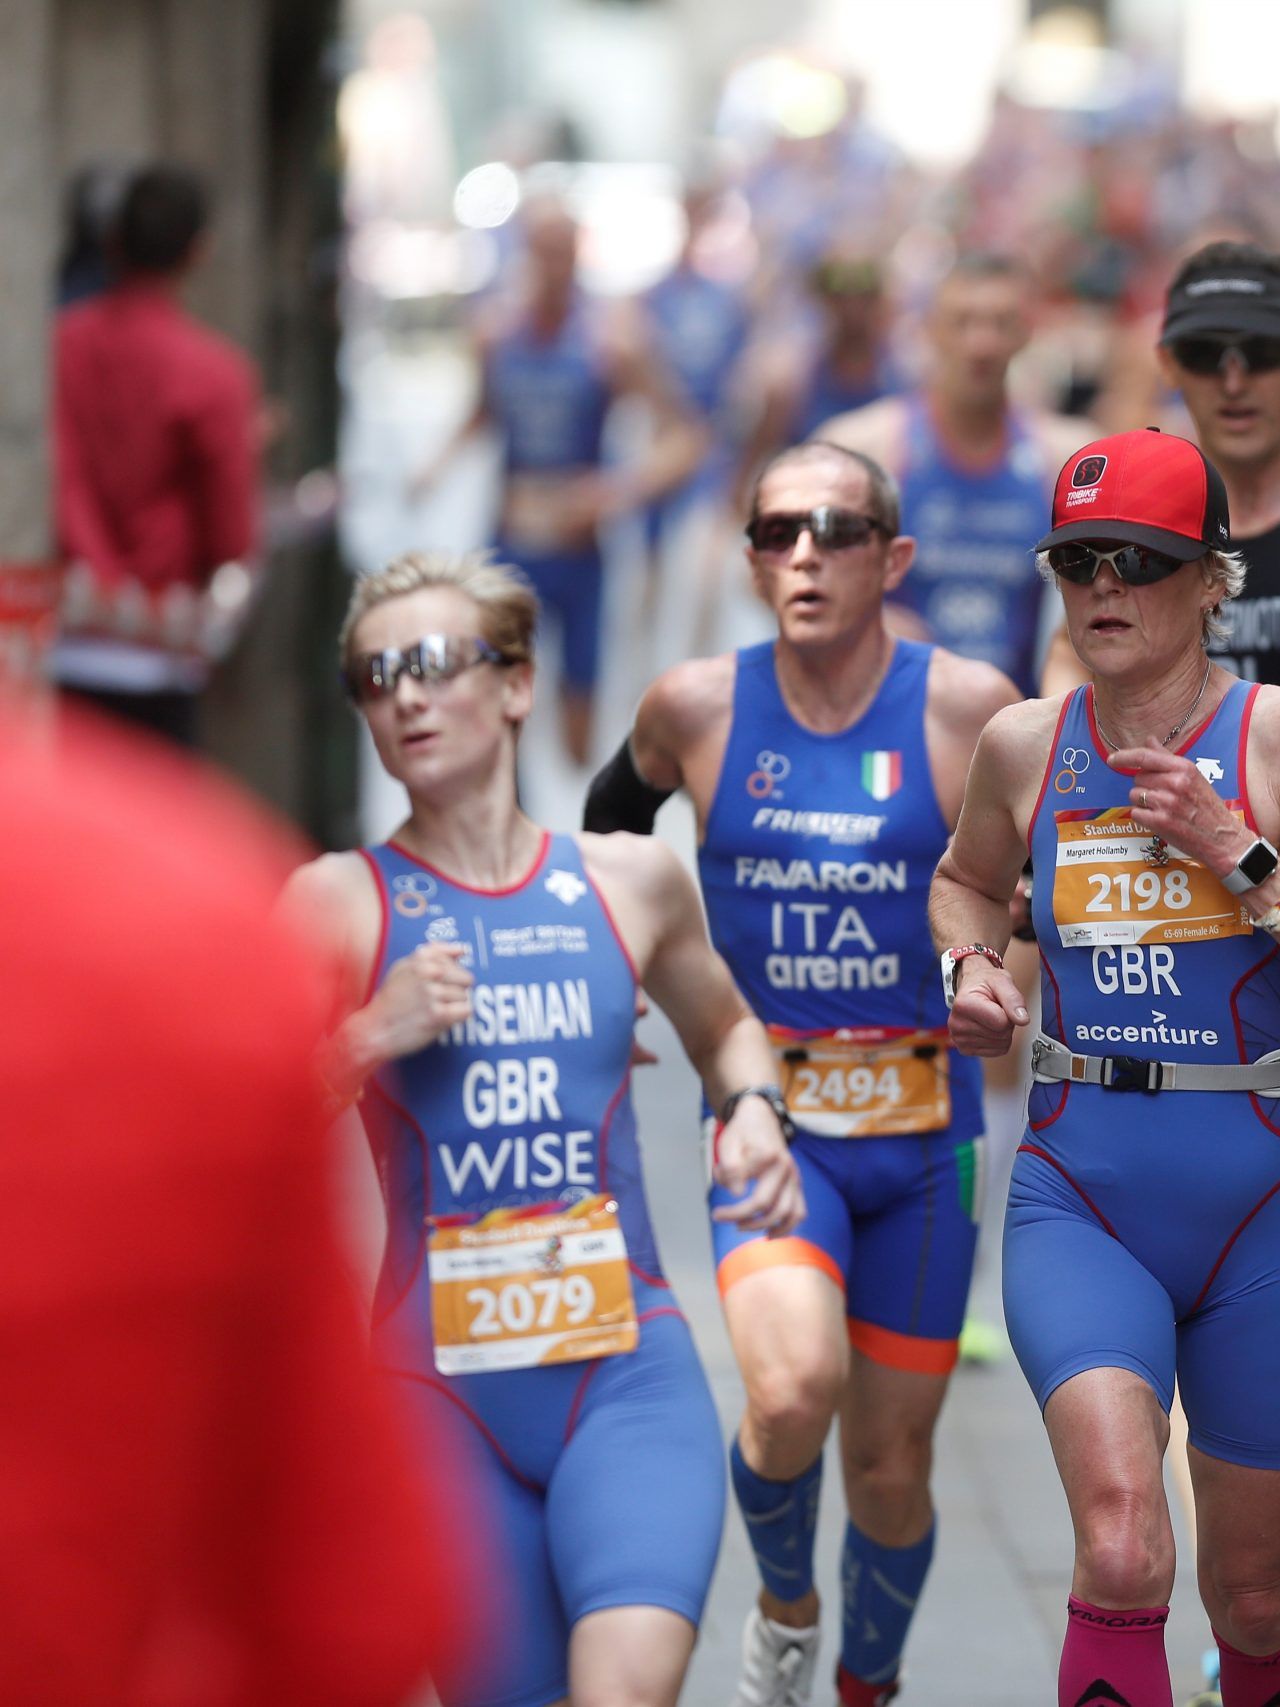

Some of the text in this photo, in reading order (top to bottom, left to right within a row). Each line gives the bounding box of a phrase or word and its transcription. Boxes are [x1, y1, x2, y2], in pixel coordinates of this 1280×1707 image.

[1065, 497, 1096, 508] TRANSPORT
[1067, 488, 1099, 501] TRIBIKE
[1084, 822, 1133, 836] Standard
[1066, 845, 1129, 858] Margaret Hollamby
[735, 856, 907, 893] FAVARON
[1085, 869, 1192, 913] 2198
[771, 902, 878, 951] ITA
[1164, 926, 1219, 939] 65-69 Female AG
[766, 954, 900, 990] arena
[1092, 944, 1182, 997] GBR
[1075, 1023, 1219, 1046] accenture
[462, 1056, 562, 1129] GBR
[794, 1065, 903, 1107] 2494
[438, 1130, 595, 1196] WISE
[466, 1274, 597, 1338] 2079
